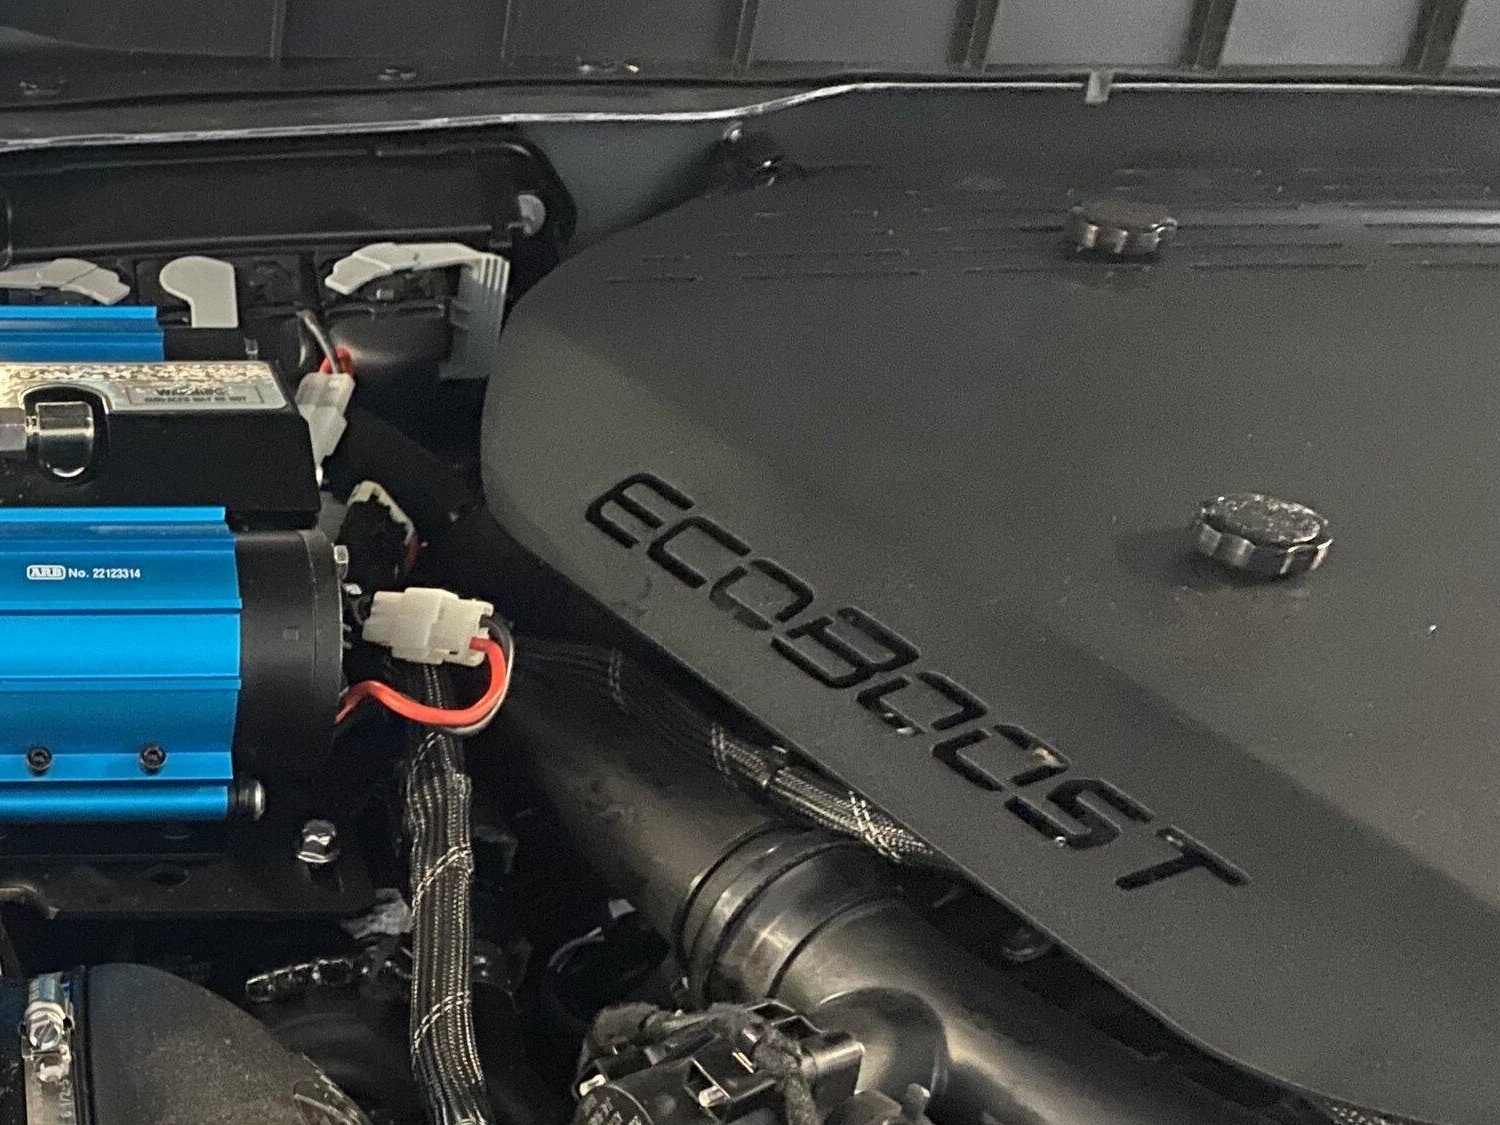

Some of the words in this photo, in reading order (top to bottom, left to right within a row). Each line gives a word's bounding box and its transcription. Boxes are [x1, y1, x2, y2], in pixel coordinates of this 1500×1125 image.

[29, 566, 63, 578] ARB
[67, 567, 90, 578] No.
[92, 567, 141, 578] 22123314
[585, 472, 1251, 890] ECOBOOST
